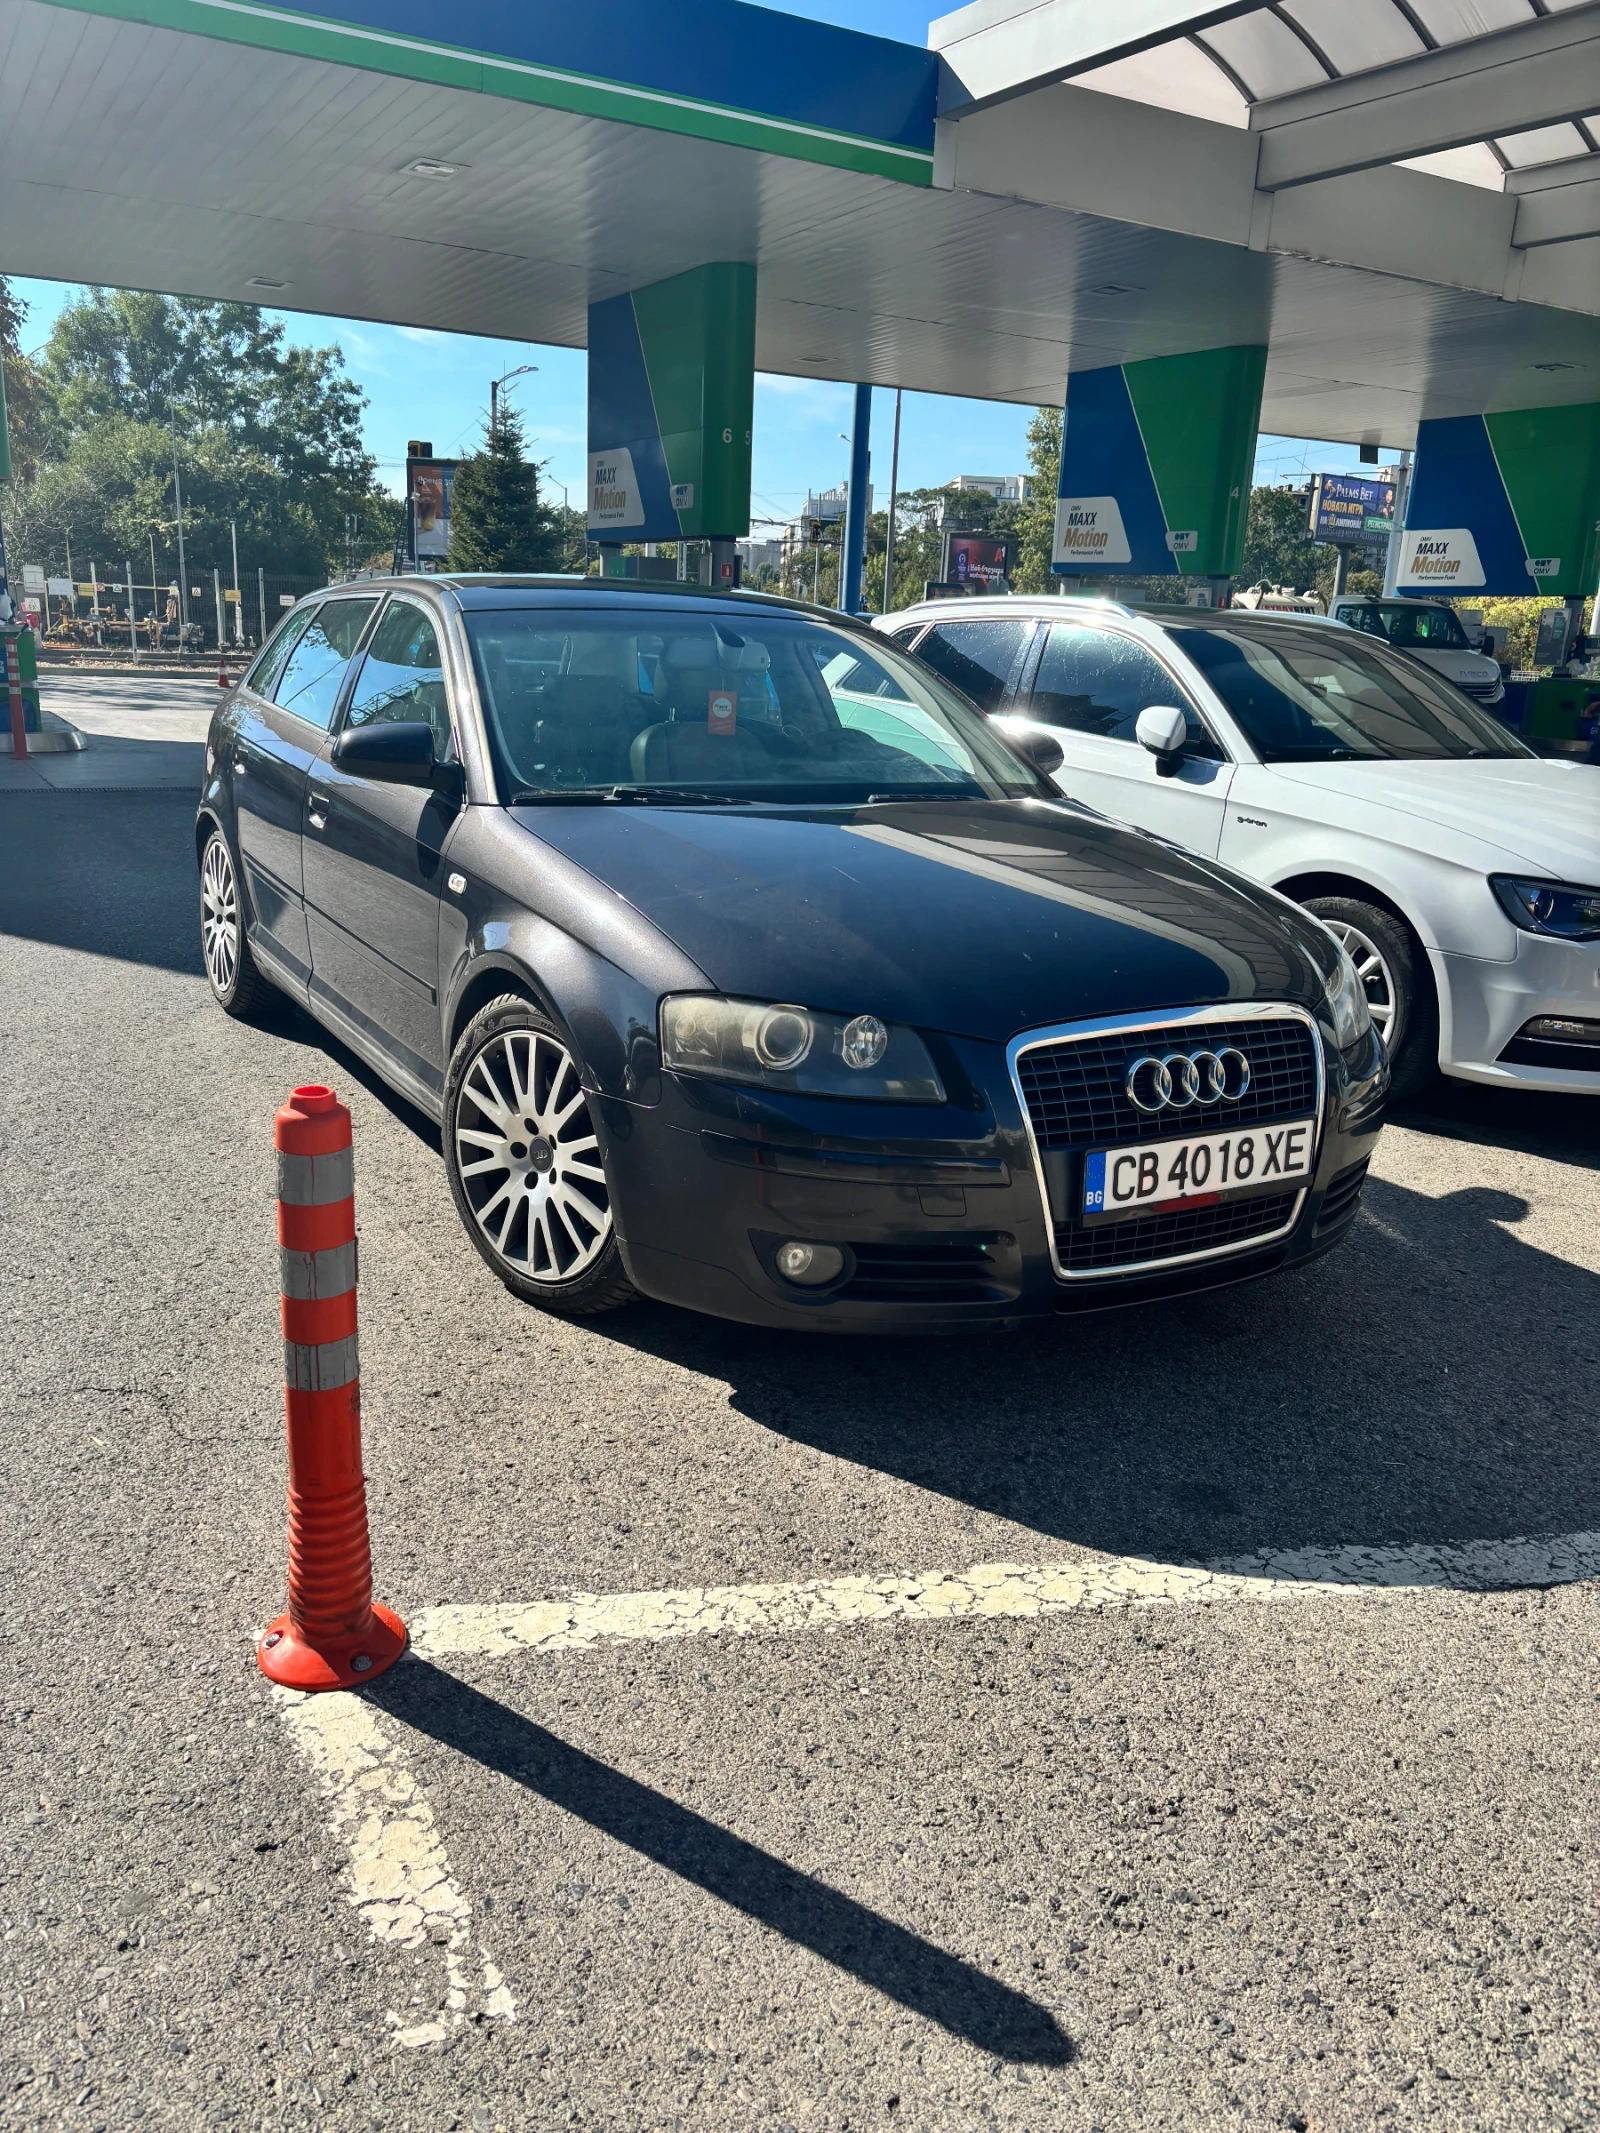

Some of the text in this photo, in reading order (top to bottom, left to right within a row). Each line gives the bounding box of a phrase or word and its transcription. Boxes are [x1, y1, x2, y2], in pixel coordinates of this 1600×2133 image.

[722, 428, 732, 443] 6
[745, 430, 751, 445] 5
[595, 467, 617, 485] MAXX
[593, 486, 626, 510] Motion
[1231, 486, 1239, 499] 4
[1336, 484, 1373, 501] PALMS BET
[1322, 499, 1364, 515] НОВАТА ИГРА
[1068, 512, 1098, 526] MAXX
[1063, 527, 1109, 548] Motion
[1173, 542, 1189, 550] OMV
[1416, 542, 1449, 555] MAXX
[994, 546, 1006, 562] A1
[1410, 555, 1461, 574] Motion
[1460, 670, 1489, 678] IVECO
[1112, 1127, 1307, 1201] CB 4018 XE
[1086, 1190, 1102, 1205] BG
